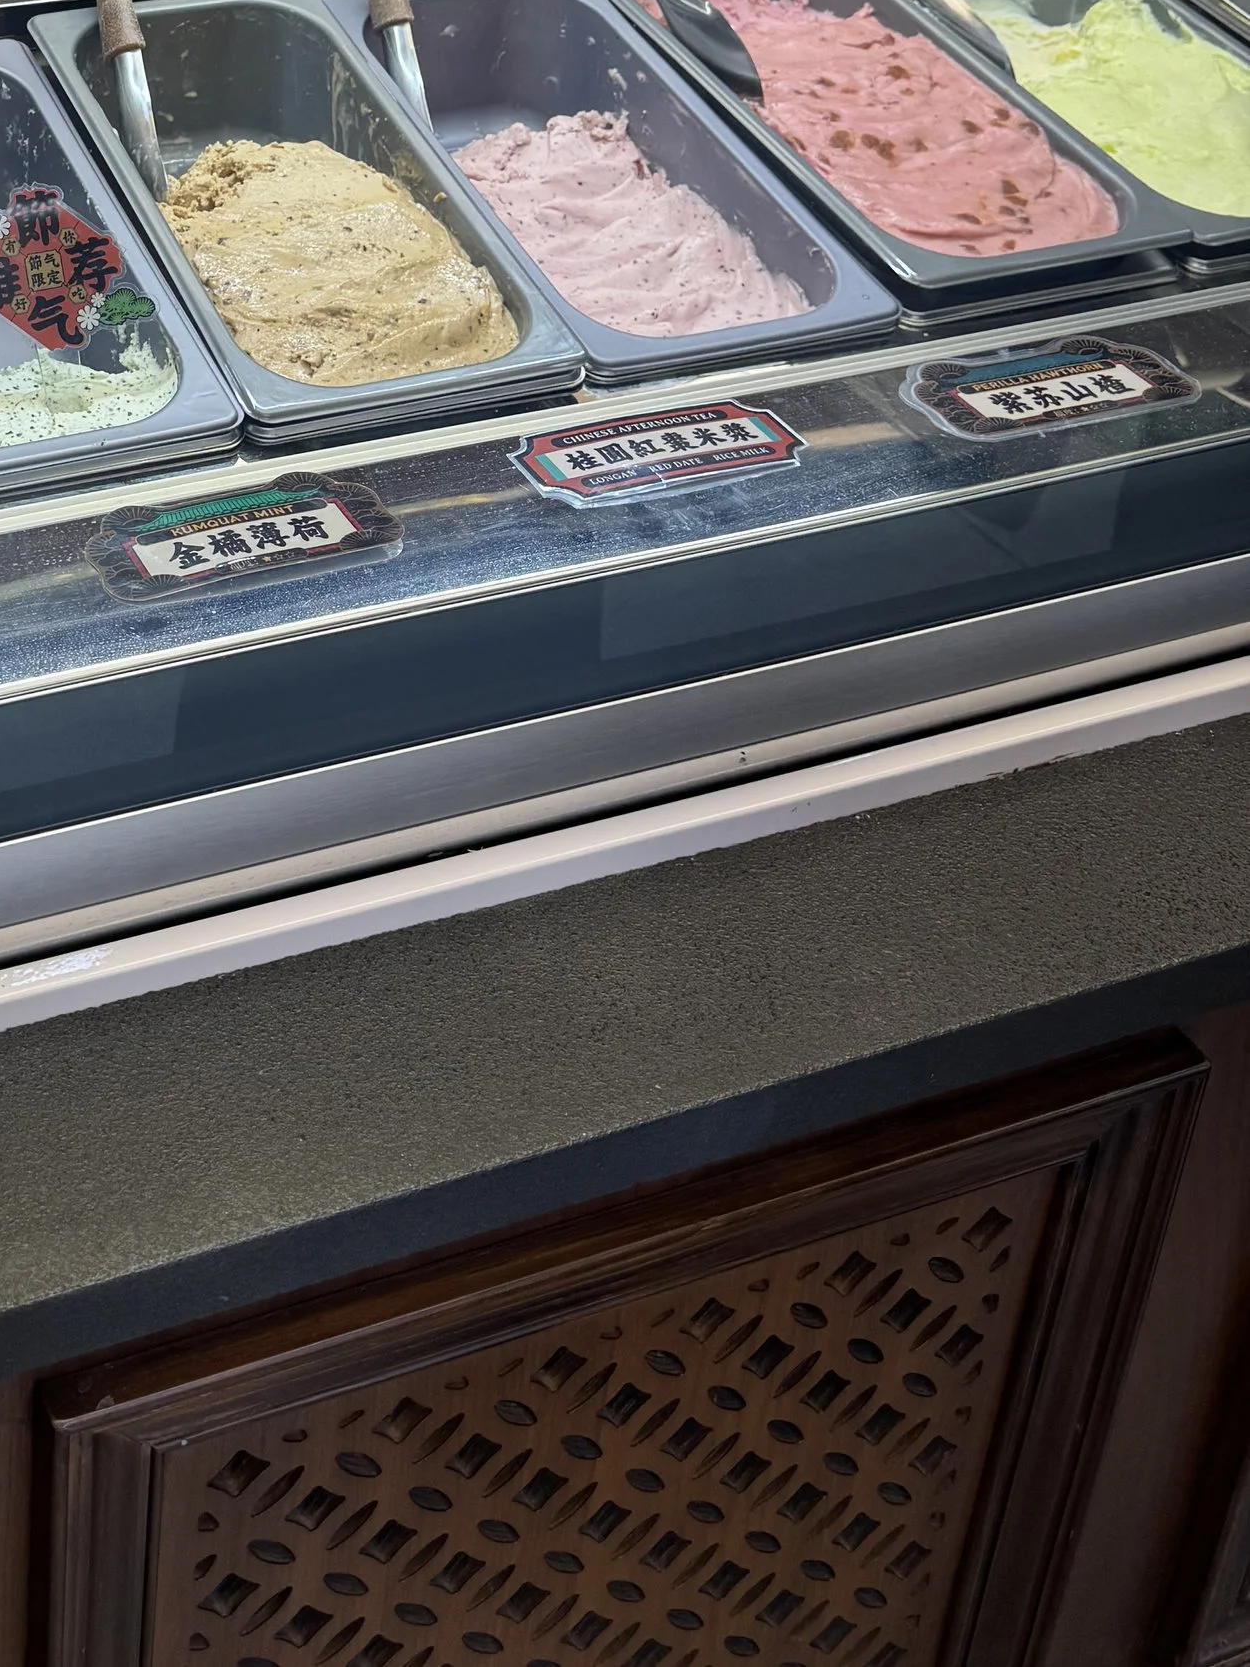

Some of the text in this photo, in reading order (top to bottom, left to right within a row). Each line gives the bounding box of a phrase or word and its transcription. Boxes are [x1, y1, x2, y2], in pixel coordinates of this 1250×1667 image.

[972, 362, 1104, 392] PERILLA HAWTHORN
[987, 374, 1137, 415] 紫苏山楂
[562, 411, 717, 445] CHINESE AFTERNOON TEA
[589, 446, 768, 485] LONGAN RED DATE RICE MILK
[171, 504, 295, 537] KUMQUAT MINT
[169, 515, 333, 570] 金橘薄荷
